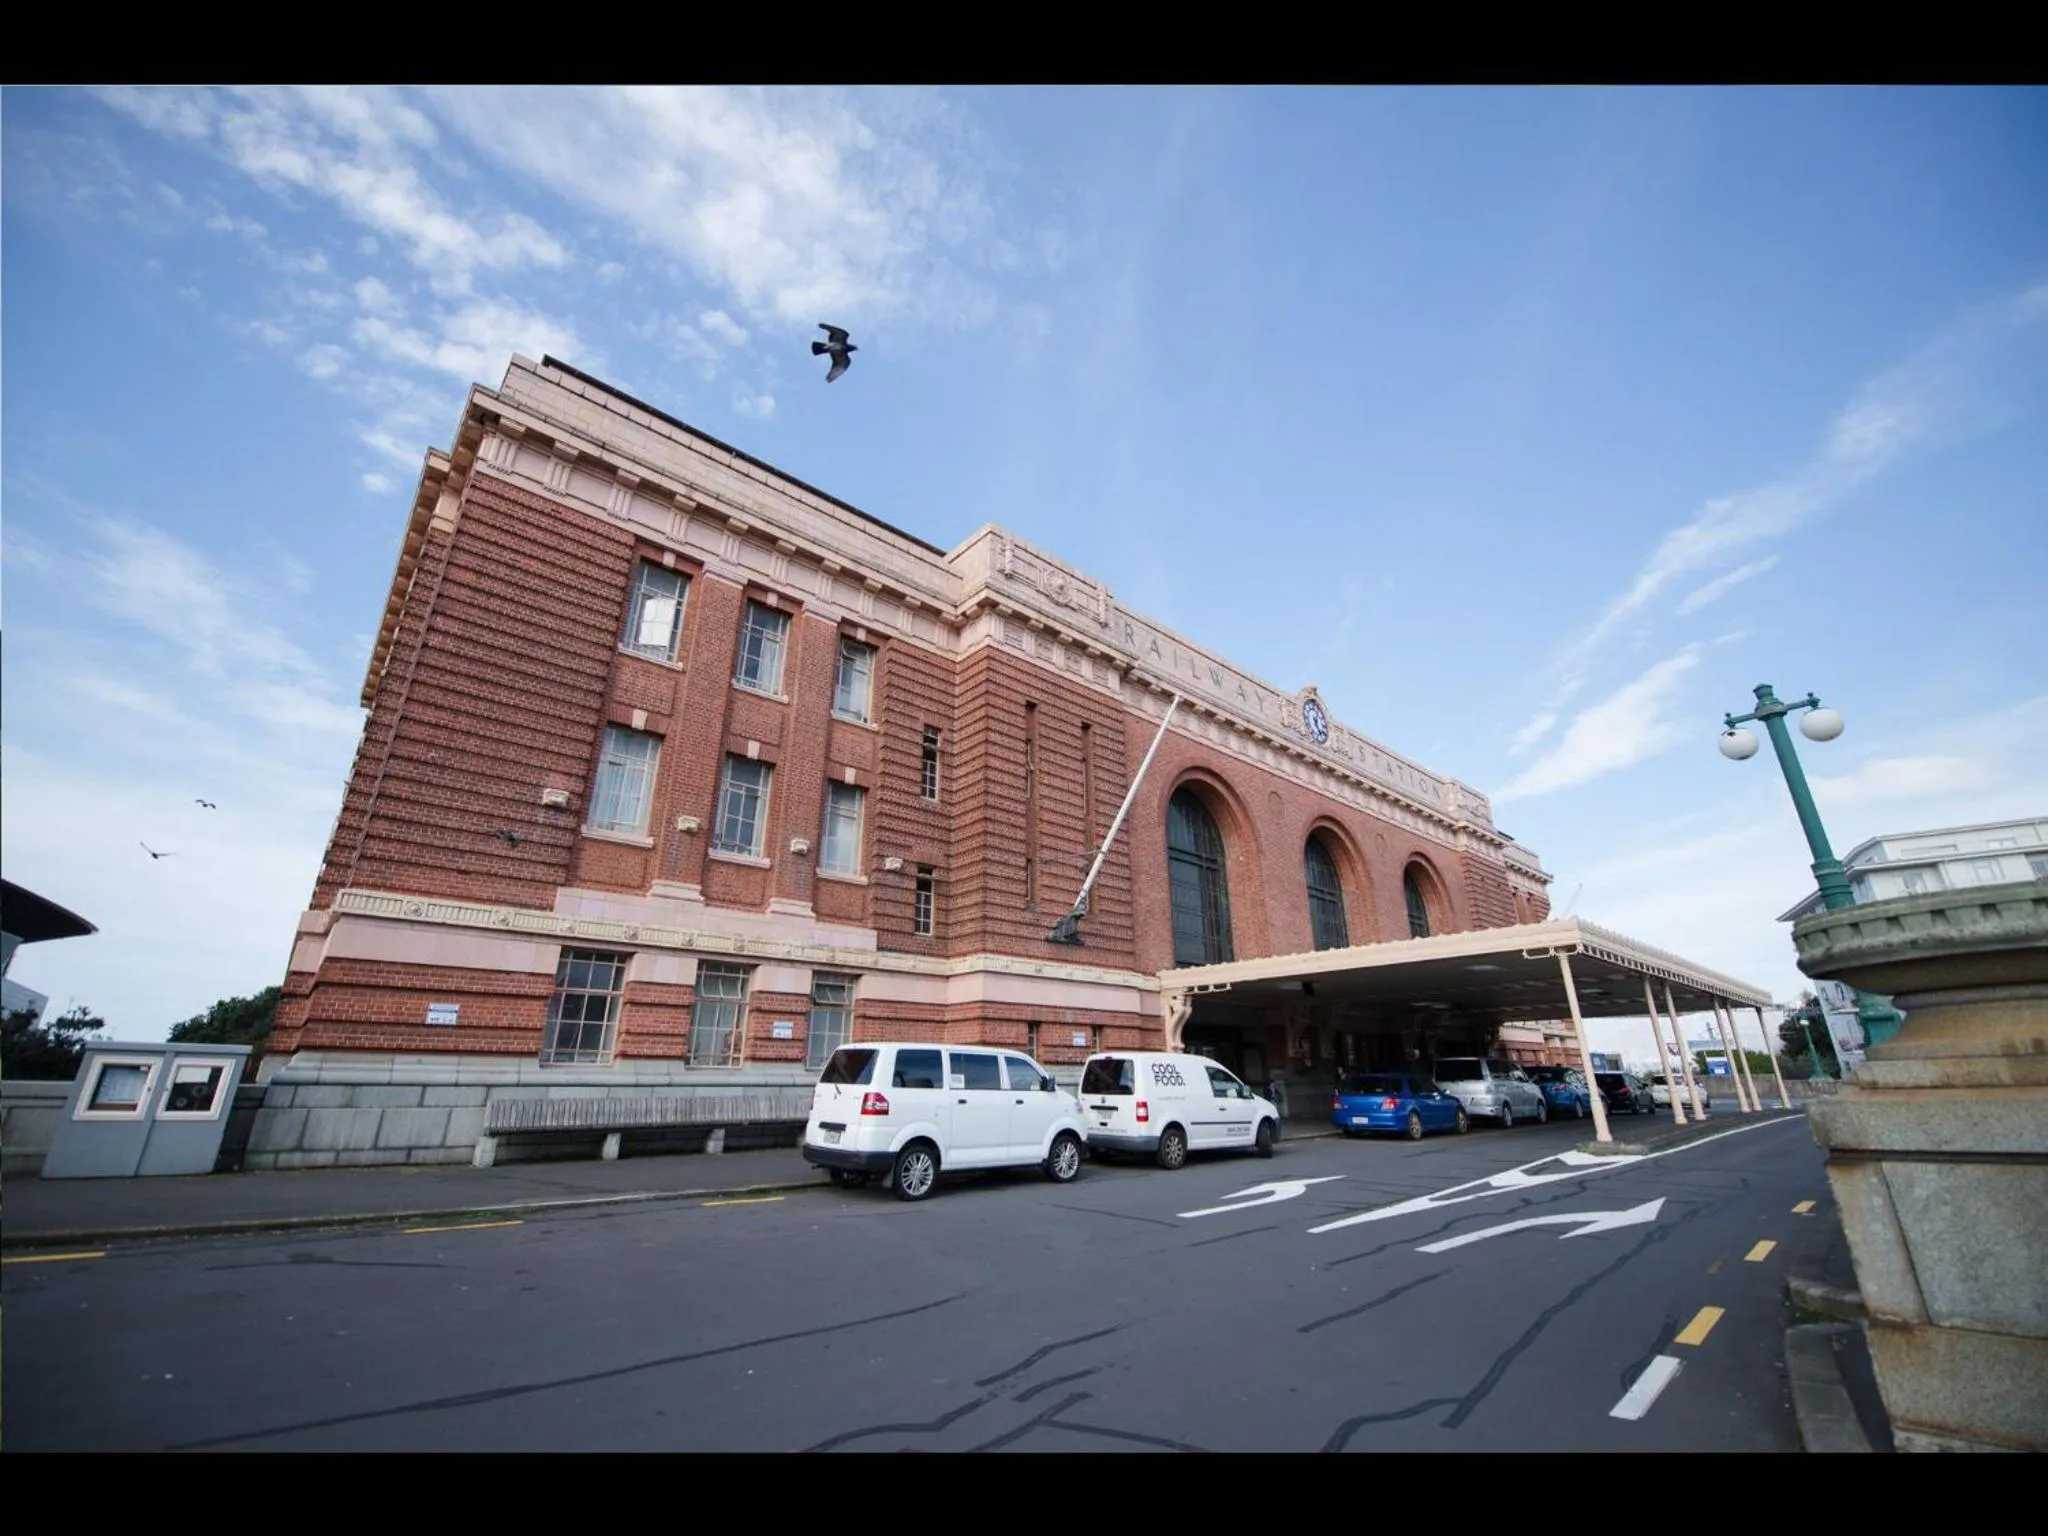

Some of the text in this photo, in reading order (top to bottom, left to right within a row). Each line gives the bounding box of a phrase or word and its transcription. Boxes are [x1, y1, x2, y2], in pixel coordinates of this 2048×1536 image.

[1124, 623, 1441, 801] RAILWAY STATION
[1151, 1063, 1180, 1075] COOL
[1154, 1075, 1186, 1087] FOOD.
